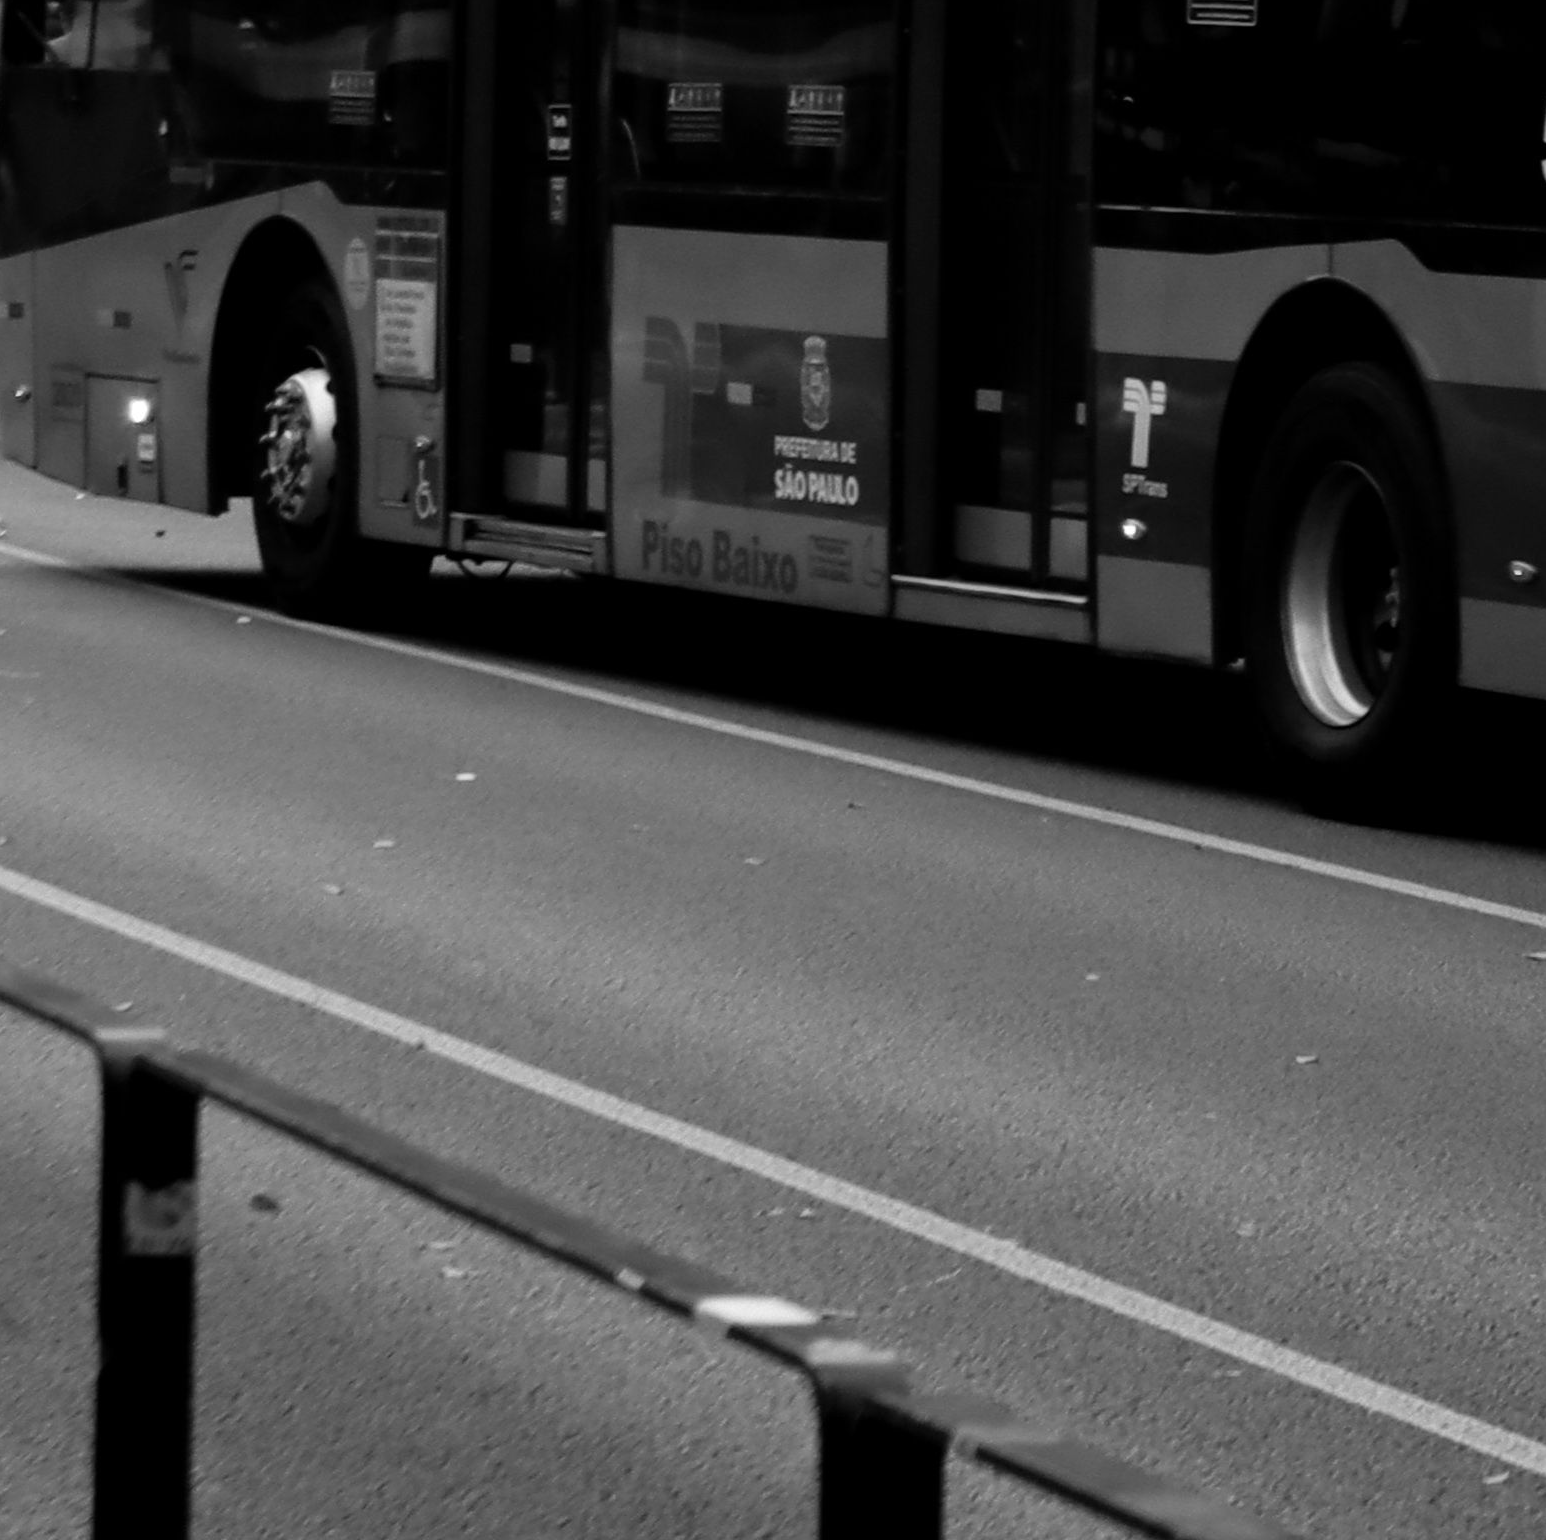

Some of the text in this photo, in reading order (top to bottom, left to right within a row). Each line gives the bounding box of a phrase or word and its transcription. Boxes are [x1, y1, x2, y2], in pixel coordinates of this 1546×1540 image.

[774, 435, 857, 464] PREFEITURA DE
[774, 463, 860, 506] SÃO PAULO
[641, 519, 707, 578] Piso
[712, 529, 799, 594] Baixo
